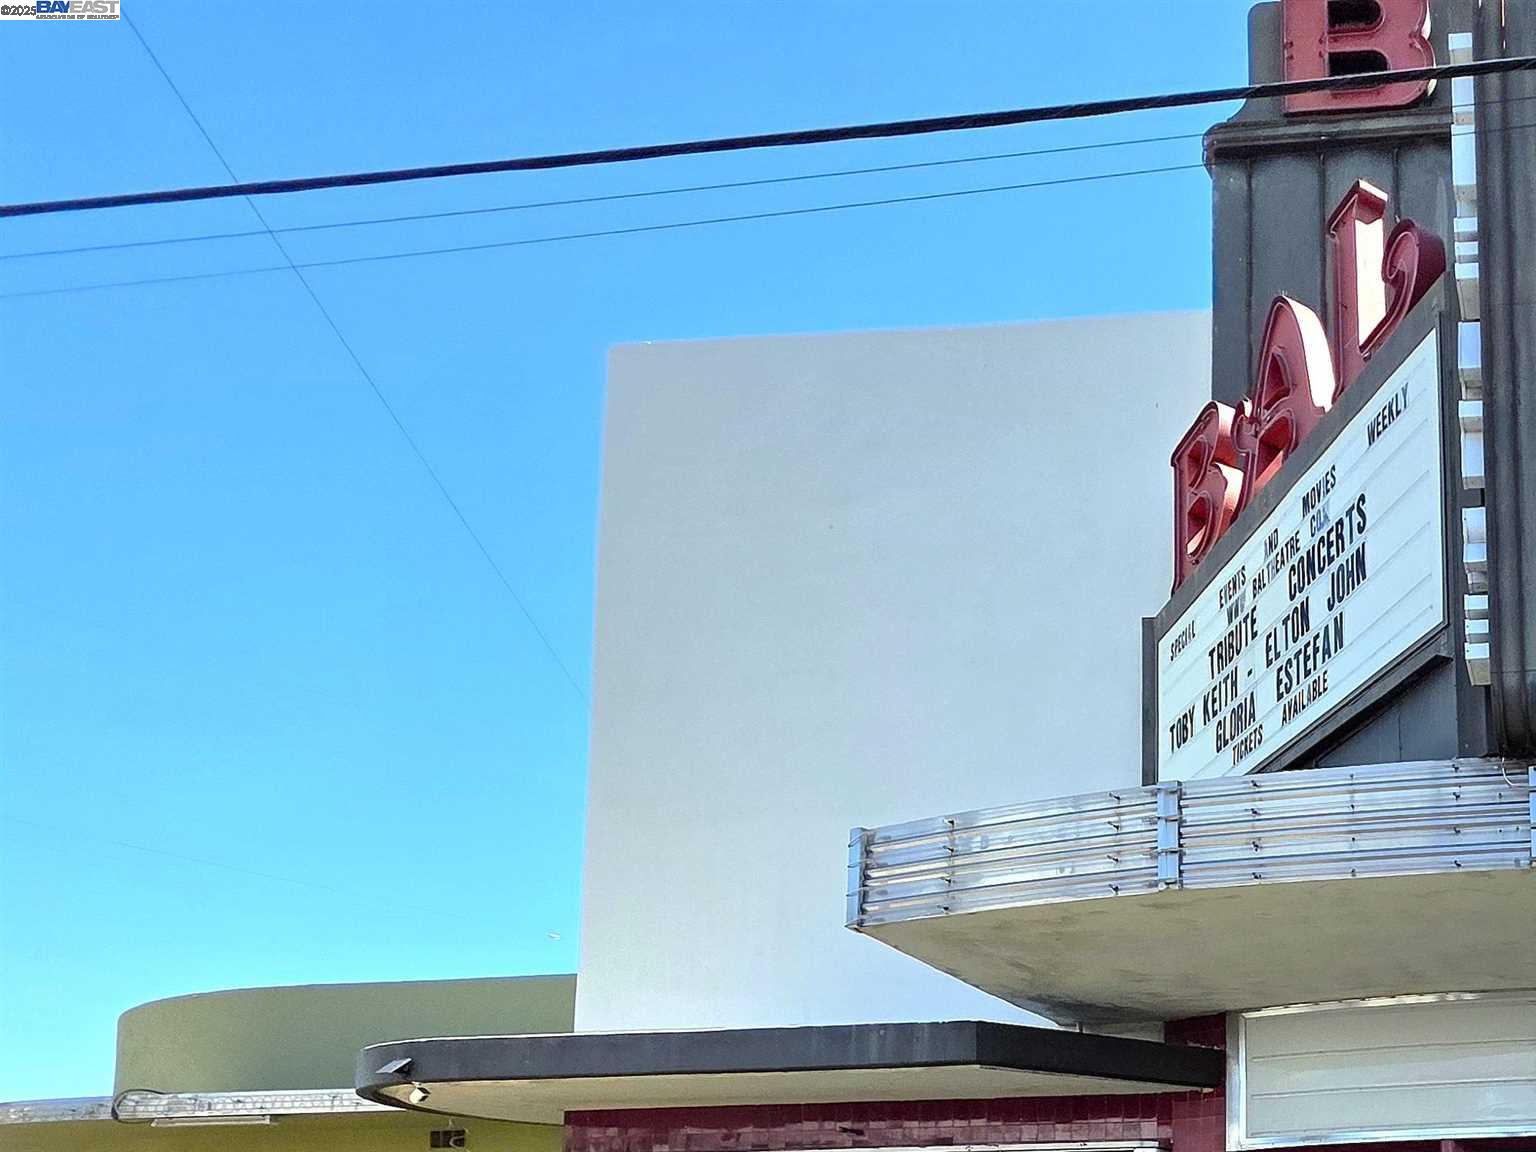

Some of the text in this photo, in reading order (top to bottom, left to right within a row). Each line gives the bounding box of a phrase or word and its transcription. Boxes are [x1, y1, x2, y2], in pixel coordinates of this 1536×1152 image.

[1170, 382, 1409, 661] SPECIAL EVENTS AND MOVIES WEEKLY
[1208, 493, 1366, 680] TRIBUTE CONCERTS
[1169, 705, 1195, 754] TOBY
[1203, 666, 1238, 727] KEITH
[1265, 595, 1310, 669] ELTON
[1327, 542, 1367, 612] JOHN
[1215, 611, 1344, 754] GLORIA ESTEFAN
[1232, 670, 1329, 766] TICKETS AVAILABLE
